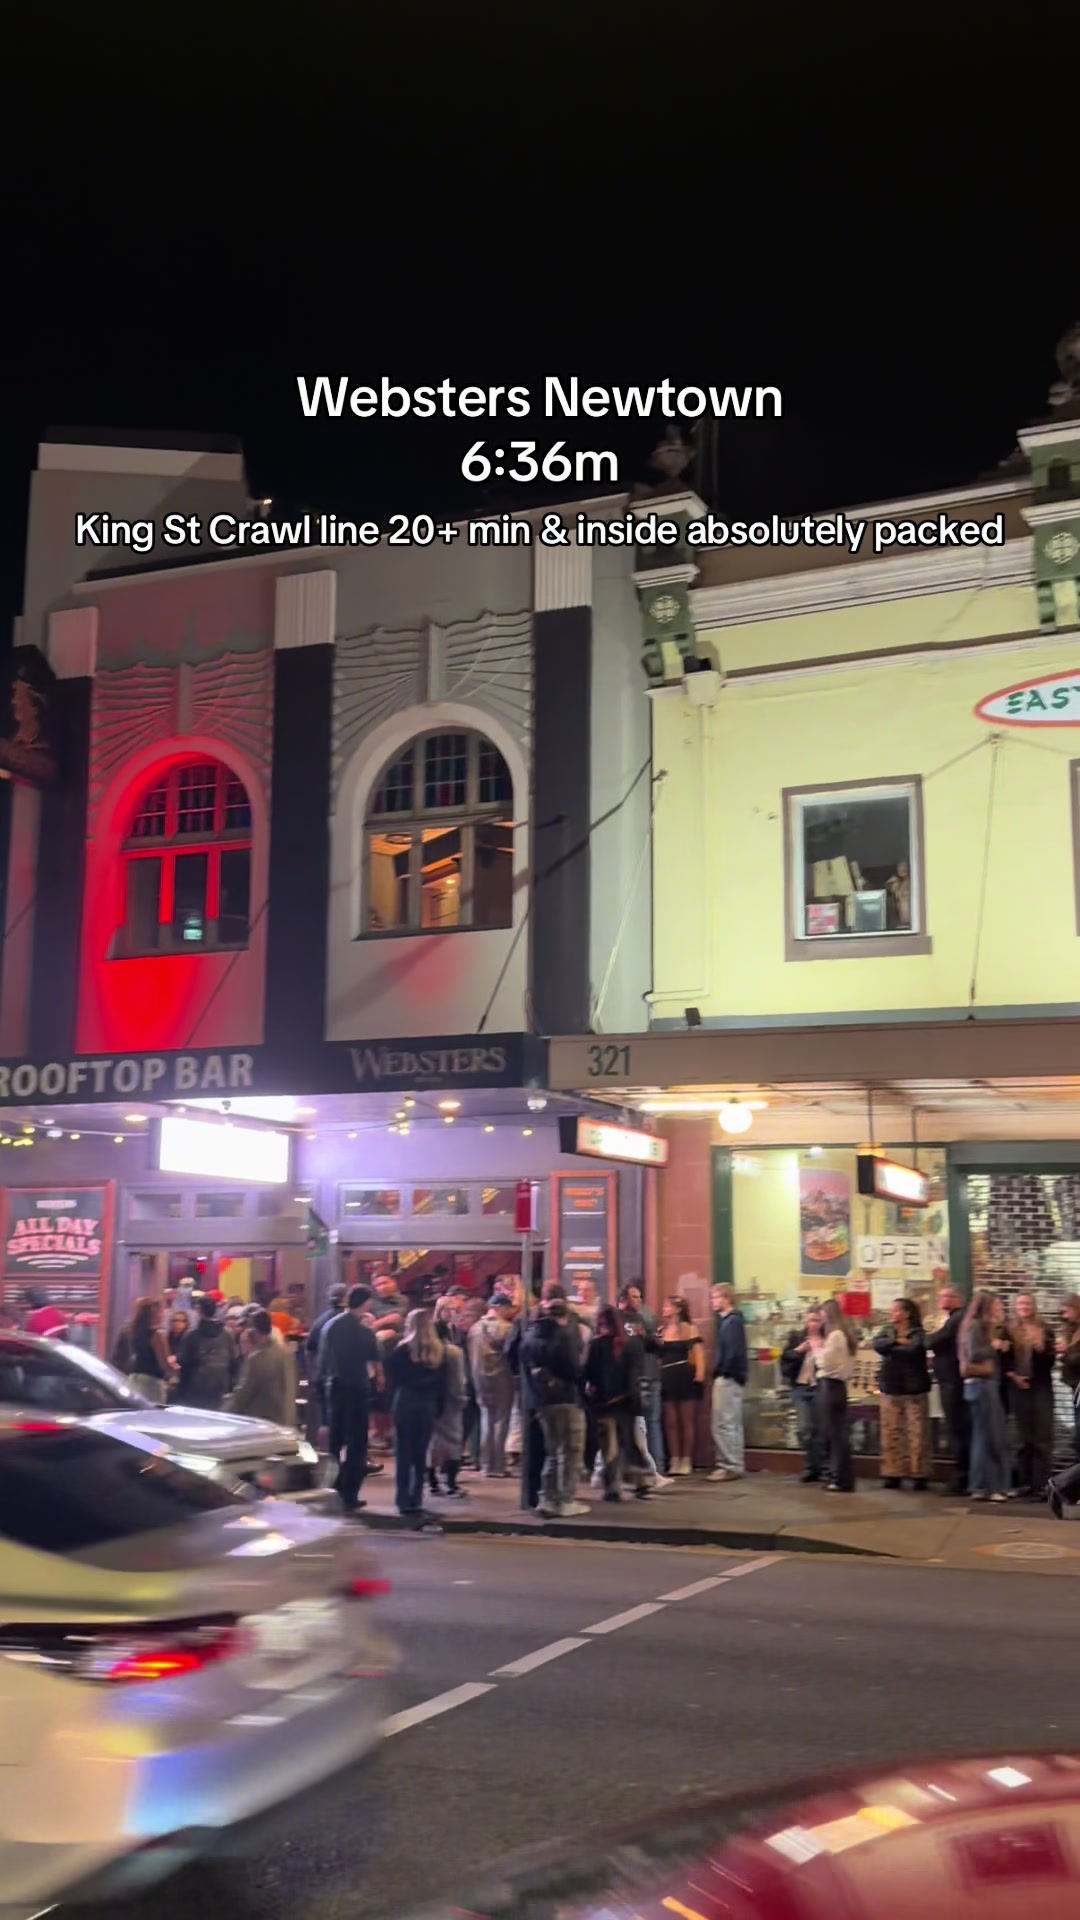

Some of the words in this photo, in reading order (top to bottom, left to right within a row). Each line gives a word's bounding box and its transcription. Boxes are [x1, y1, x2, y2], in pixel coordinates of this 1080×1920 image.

[174, 1053, 254, 1090] BAR
[588, 1045, 631, 1077] 321
[13, 1216, 54, 1237] ALL
[56, 1216, 99, 1236] DAY
[7, 1235, 101, 1256] SPECIALS
